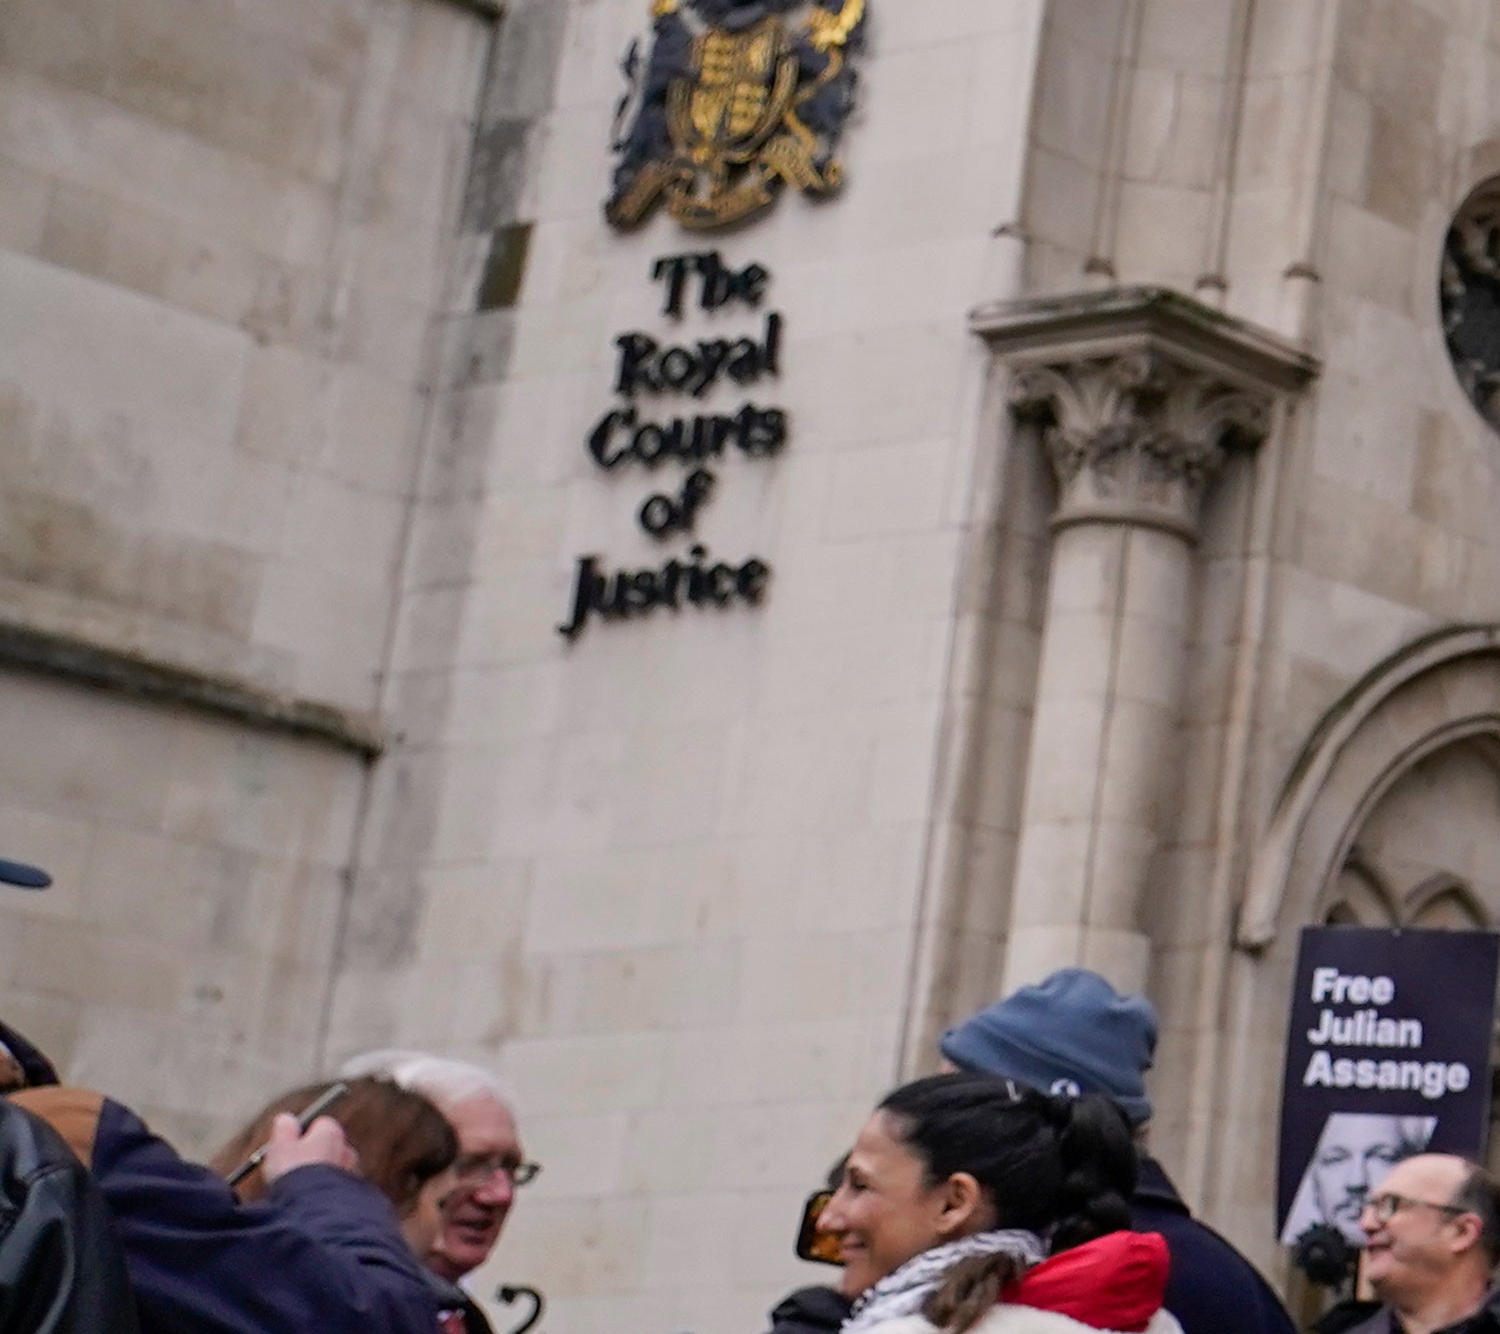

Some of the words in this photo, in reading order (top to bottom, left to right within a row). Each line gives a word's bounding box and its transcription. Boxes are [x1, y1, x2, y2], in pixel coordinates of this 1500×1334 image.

[652, 253, 769, 319] The
[614, 312, 784, 398] Royal
[587, 404, 789, 470] Courts
[640, 468, 715, 536] of
[558, 545, 771, 641] Justice
[1311, 967, 1395, 1005] Free
[1307, 1009, 1423, 1048] Julian
[1303, 1050, 1471, 1099] Assange
